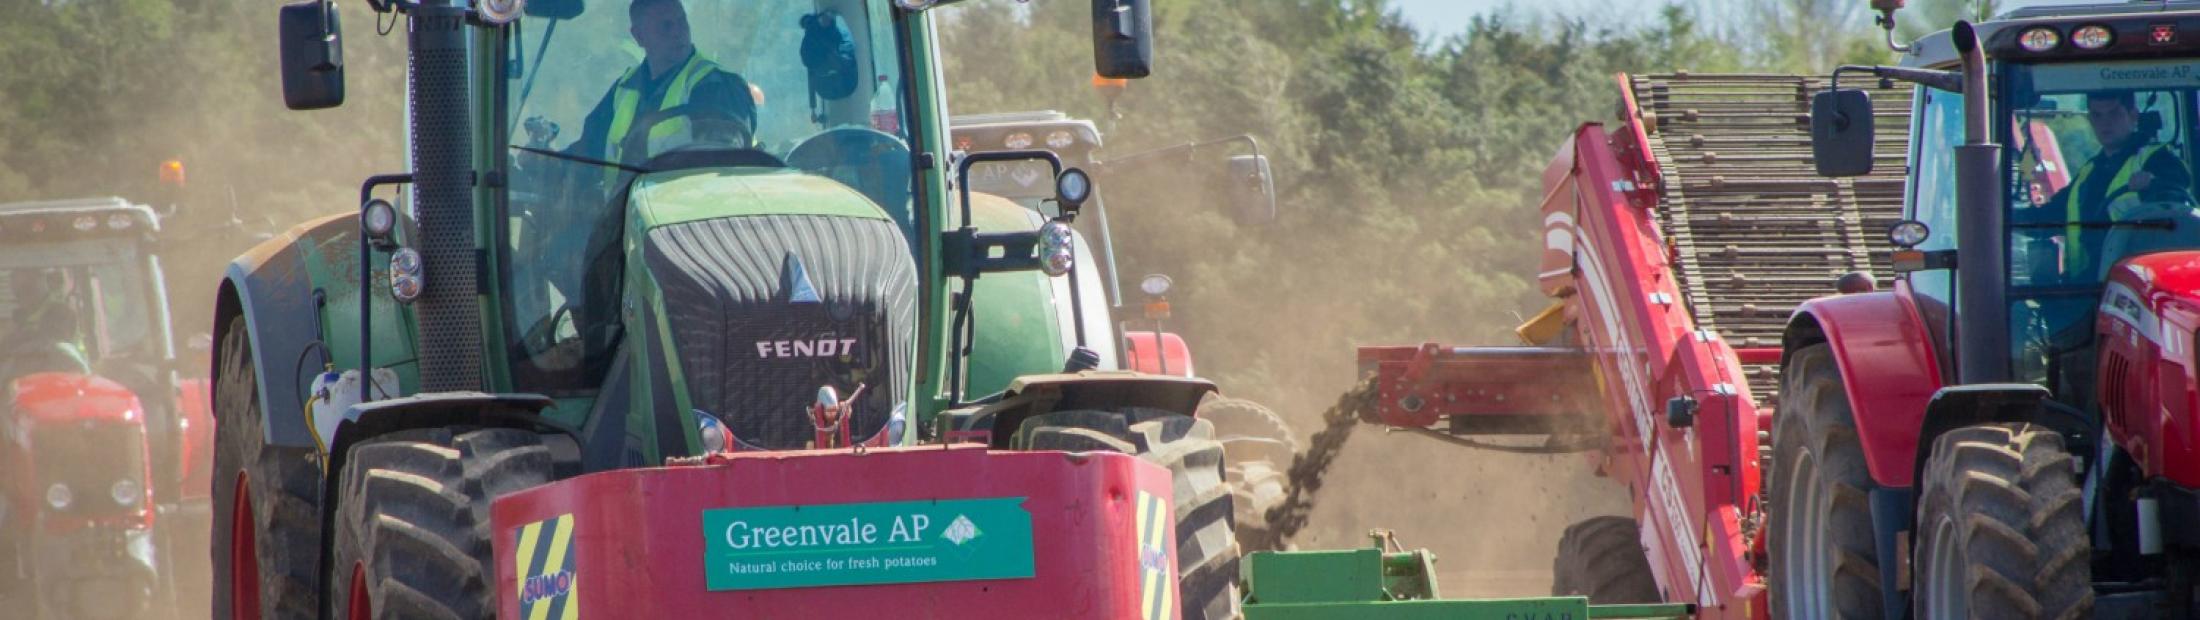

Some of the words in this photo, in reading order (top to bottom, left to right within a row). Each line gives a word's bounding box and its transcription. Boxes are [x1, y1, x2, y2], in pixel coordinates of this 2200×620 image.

[2100, 67, 2167, 79] Greenvale
[2172, 65, 2191, 78] AP
[756, 338, 857, 358] FENDT
[725, 518, 878, 549] Greenvale
[888, 514, 930, 543] AP
[729, 560, 777, 574] Natural
[781, 558, 822, 572] choice
[826, 557, 844, 570] for
[848, 556, 879, 569] fresh
[885, 555, 937, 569] potatoes
[523, 570, 571, 603] SUMO
